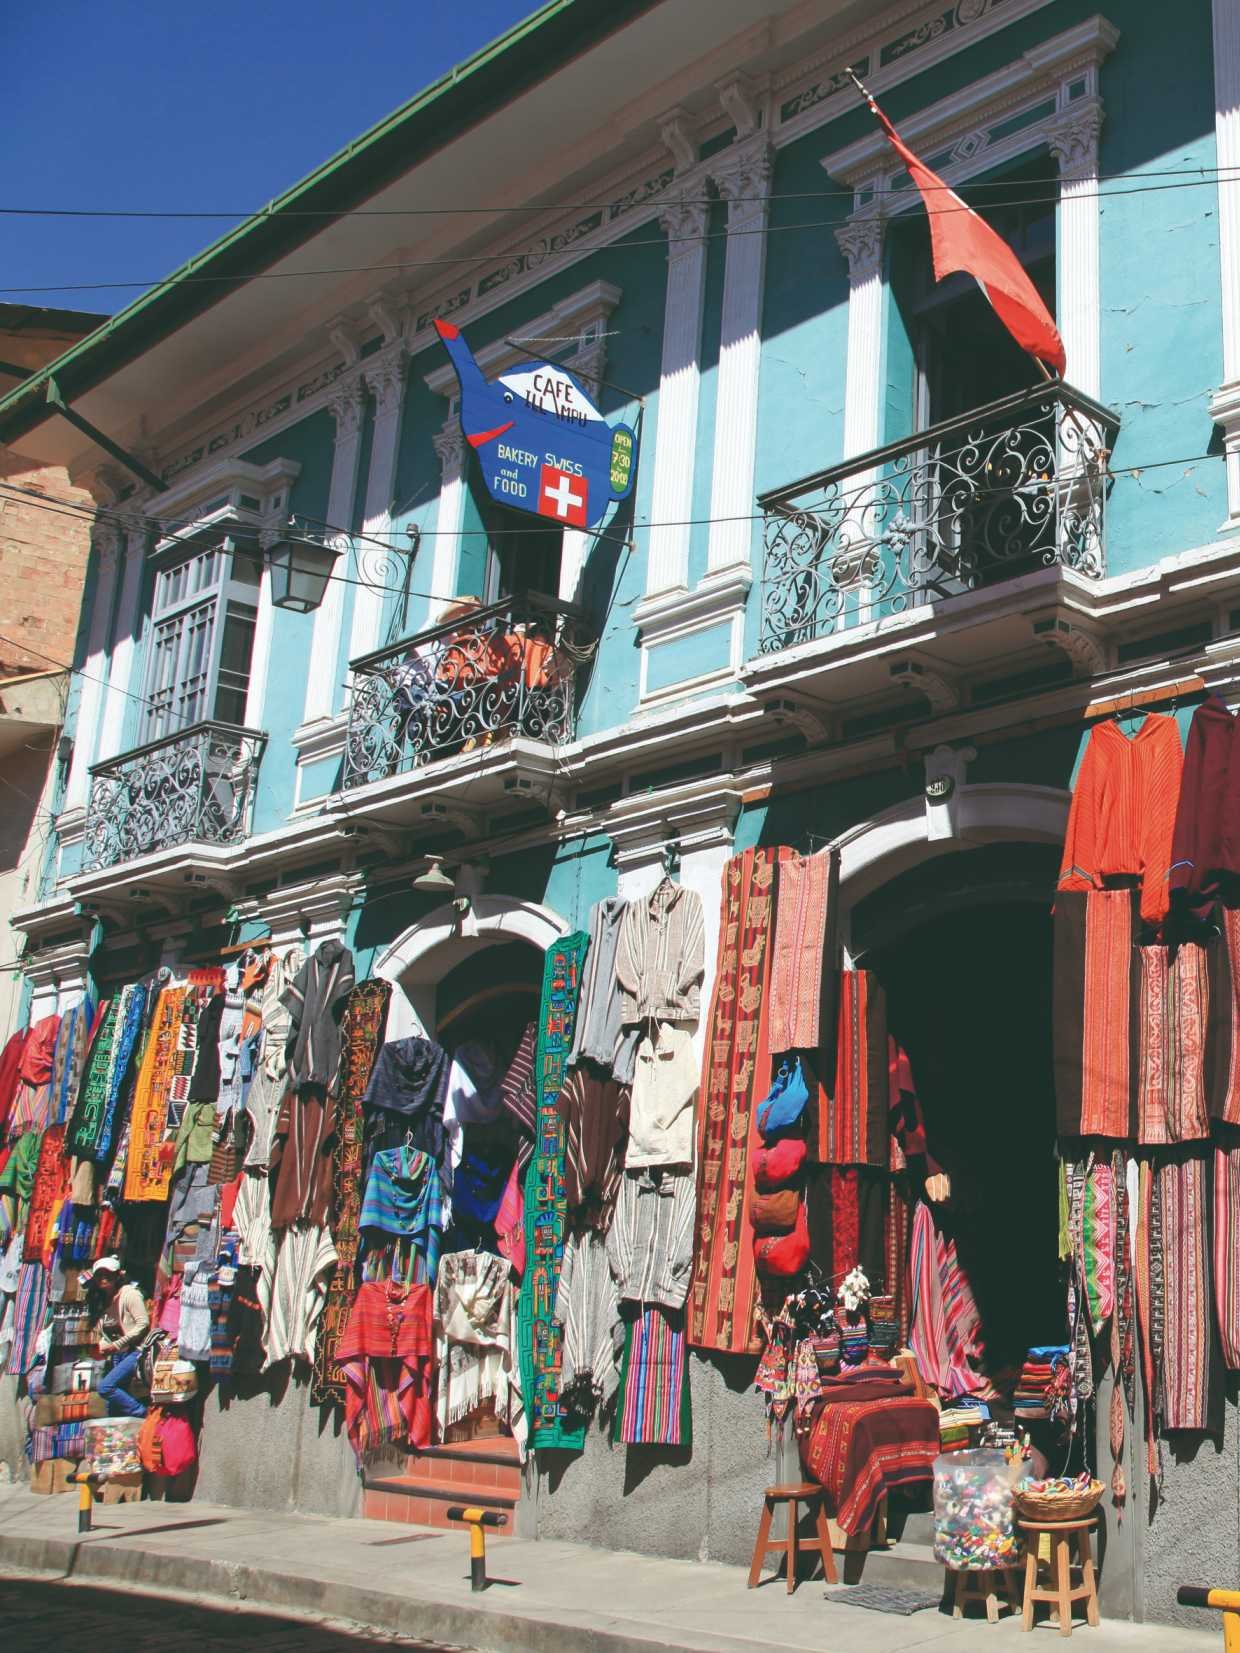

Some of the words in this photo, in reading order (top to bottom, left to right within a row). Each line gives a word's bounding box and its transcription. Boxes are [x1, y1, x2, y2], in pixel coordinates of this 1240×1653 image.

[533, 374, 574, 405] CAFE
[497, 444, 538, 469] BAKERY
[544, 453, 584, 477] SWISS
[494, 476, 528, 498] FOOD
[500, 468, 519, 480] and
